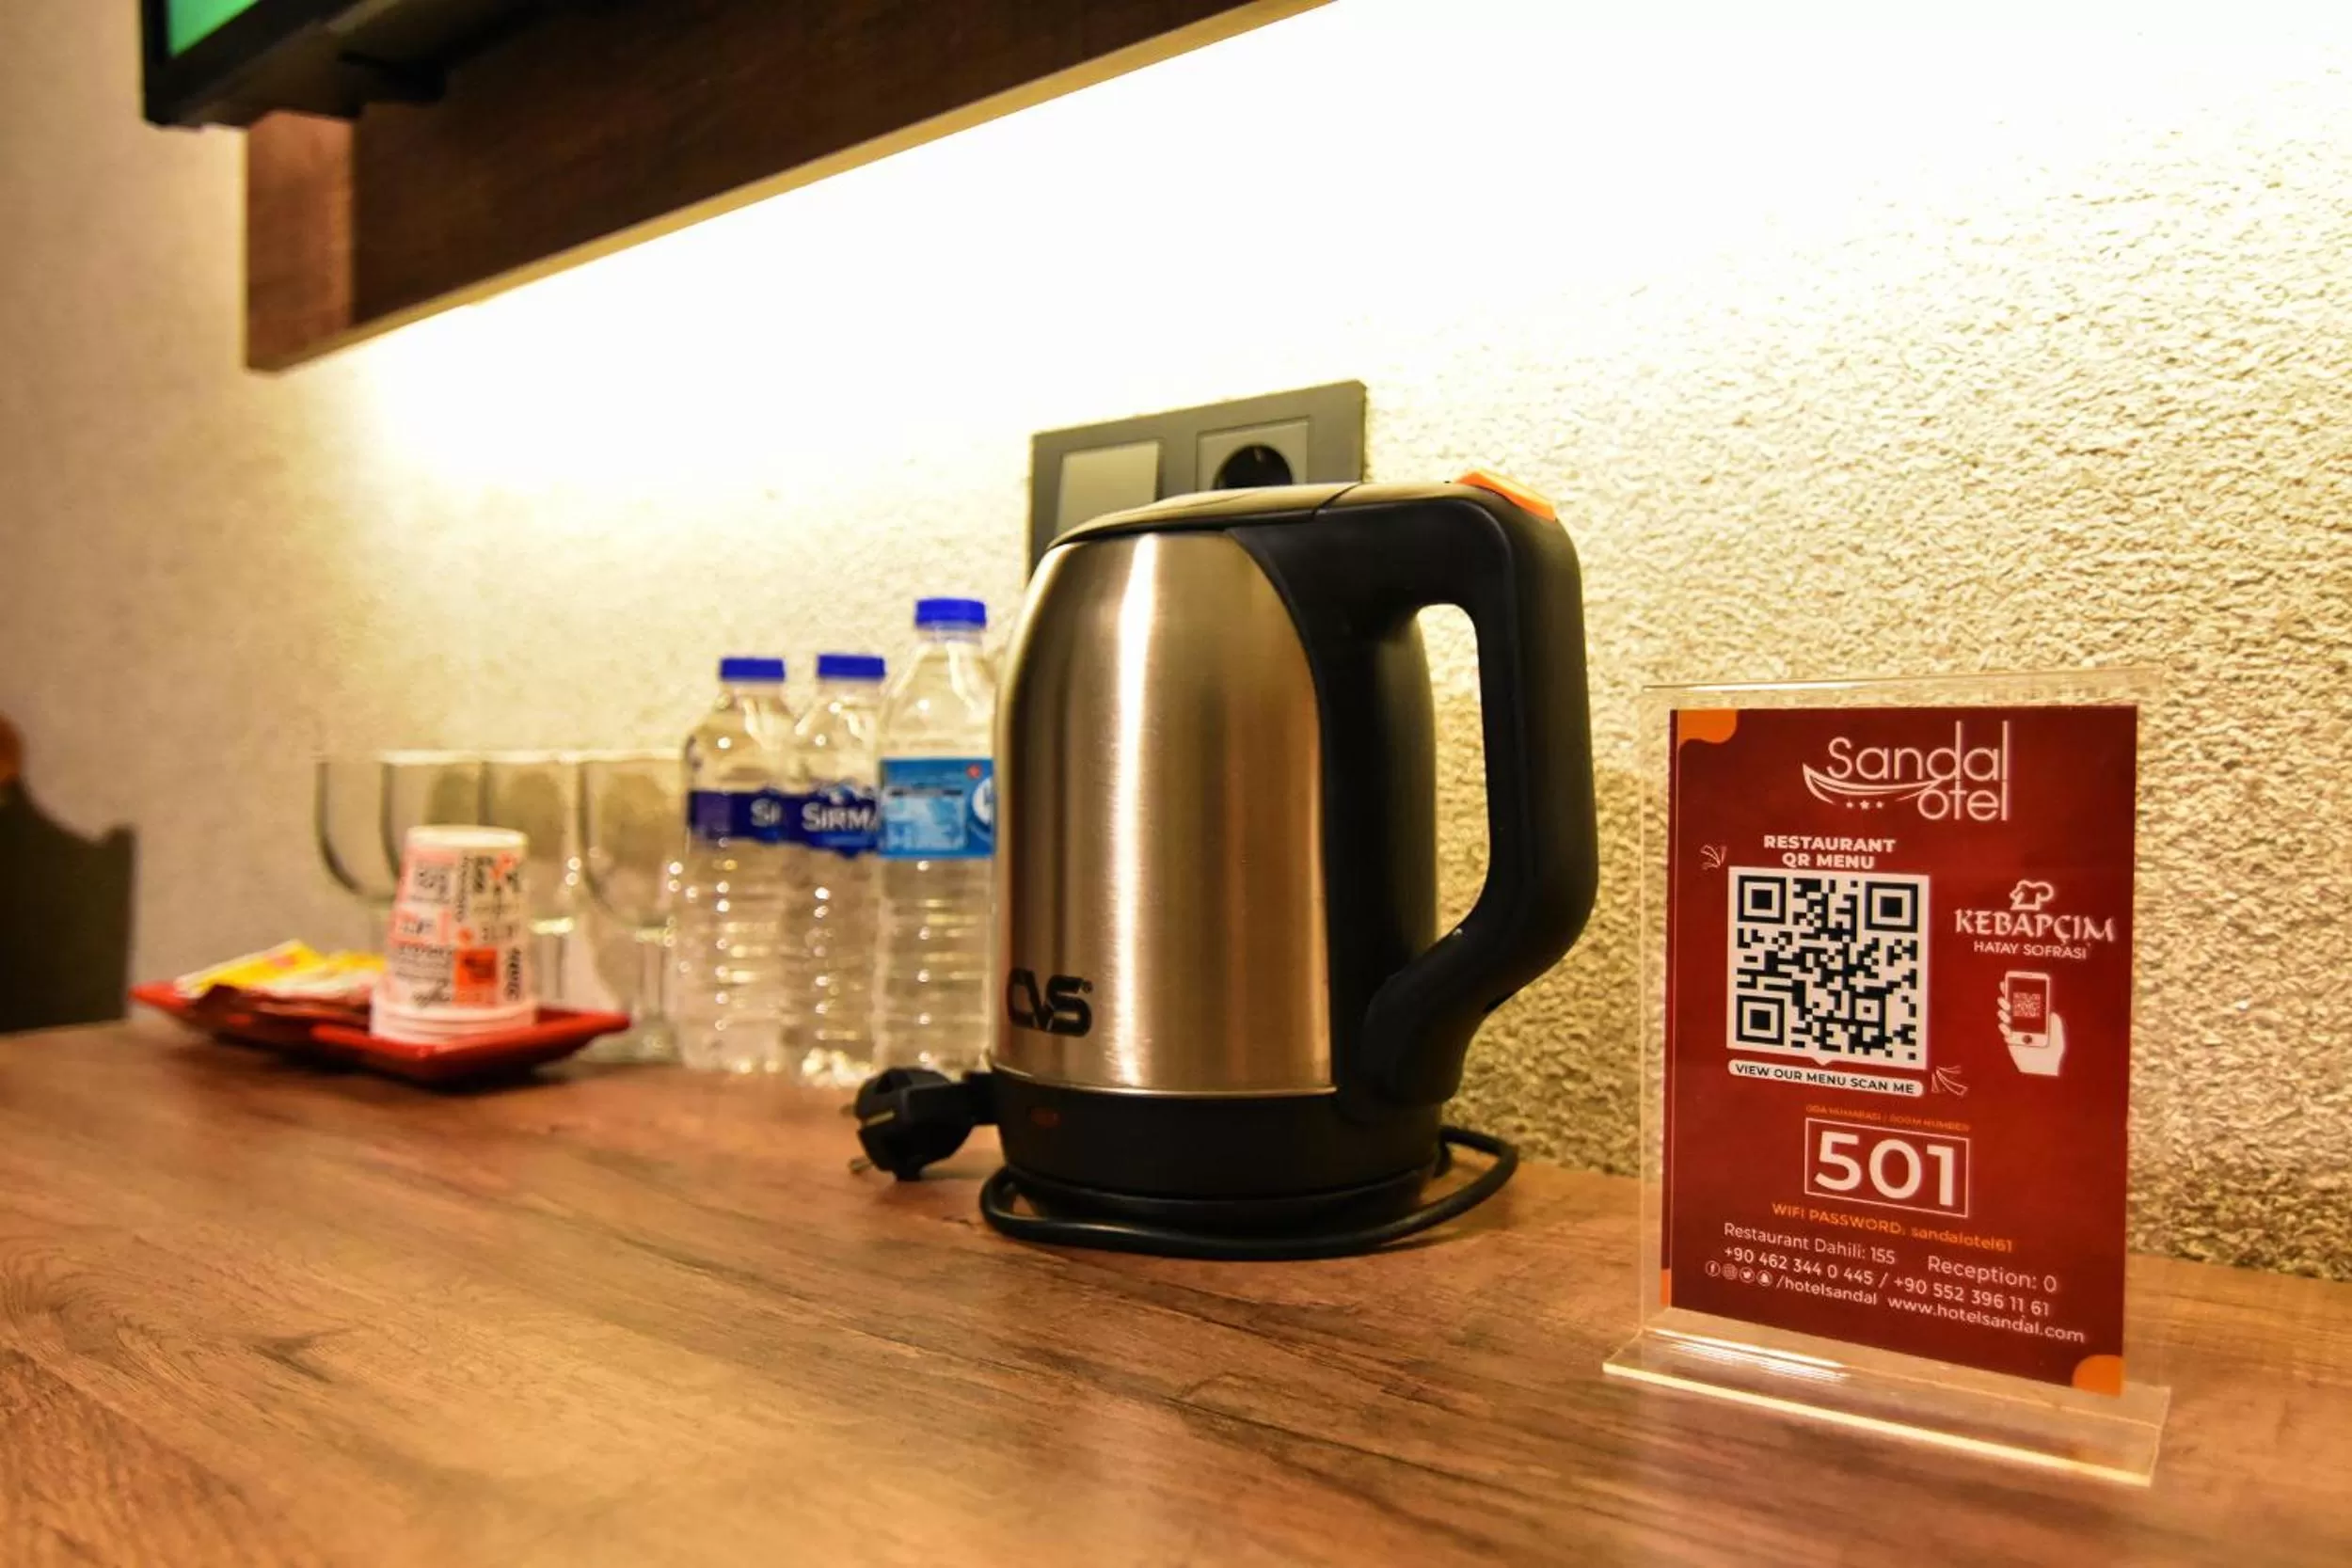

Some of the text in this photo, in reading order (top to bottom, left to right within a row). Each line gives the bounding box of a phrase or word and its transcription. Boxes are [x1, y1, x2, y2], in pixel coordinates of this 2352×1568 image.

[1827, 721, 2010, 781] Sandal
[1917, 782, 2009, 821] otel
[1763, 834, 1897, 853] RESTAURANT
[1782, 852, 1876, 870] QR MENU
[1954, 909, 2116, 945] KEBAPÇIM
[1974, 942, 2087, 959] HATAY SOFRASI
[1735, 1063, 1915, 1094] VIEW OUR MENU SCAN ME
[1814, 1131, 1955, 1207] 501
[1724, 1222, 1897, 1265] Restaurant Dahili: 155
[1772, 1203, 1805, 1218] WIFI
[1911, 1226, 2013, 1254] sandalotel61
[1724, 1246, 2050, 1317] +90 462 344 0 445 / +90 552 396 11 61
[1928, 1255, 2058, 1293] Reception: 0
[1776, 1275, 2085, 1343] /hotelsandal www.hotelsandal.com
